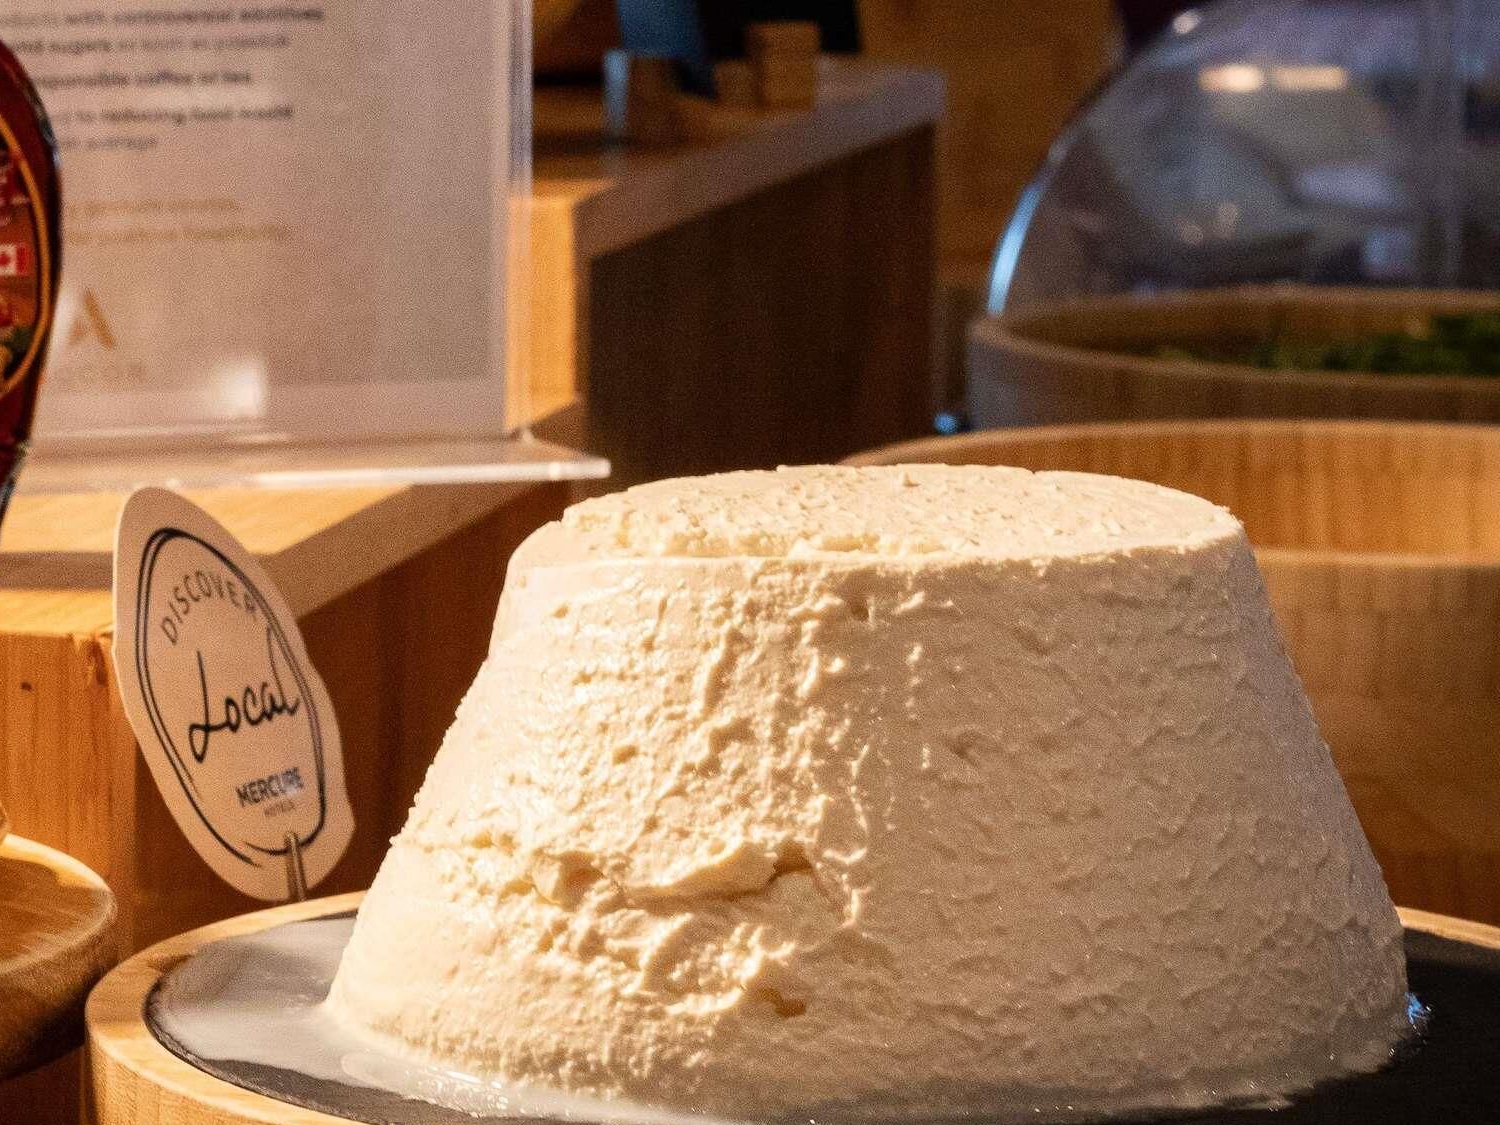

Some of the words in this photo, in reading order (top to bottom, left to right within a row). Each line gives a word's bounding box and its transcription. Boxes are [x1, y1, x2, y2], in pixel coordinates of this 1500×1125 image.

[159, 569, 258, 647] DISCOVER
[188, 625, 301, 765] Local
[236, 767, 304, 809] MERCURE
